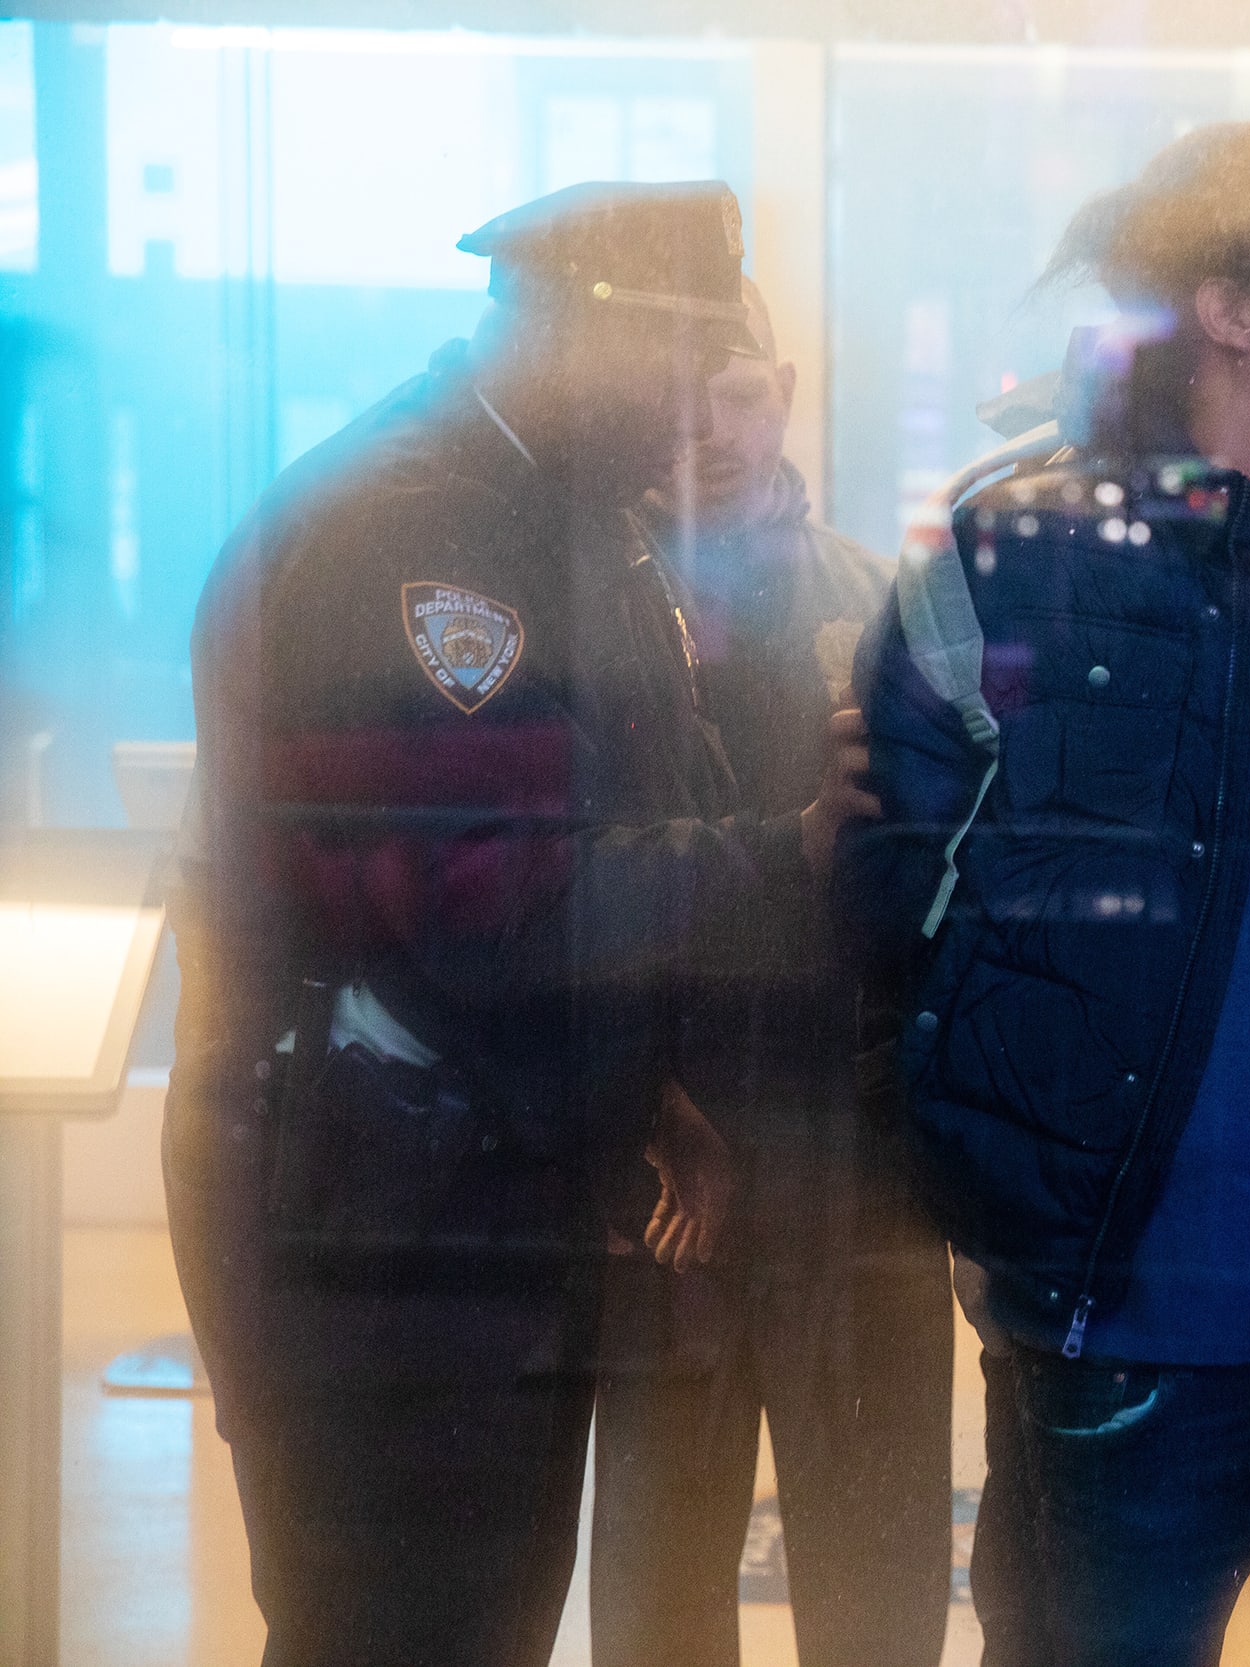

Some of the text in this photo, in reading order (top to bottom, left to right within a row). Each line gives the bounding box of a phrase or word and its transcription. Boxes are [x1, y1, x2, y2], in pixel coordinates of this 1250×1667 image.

[415, 633, 456, 689] CITY OF
[476, 664, 503, 695] NEW
